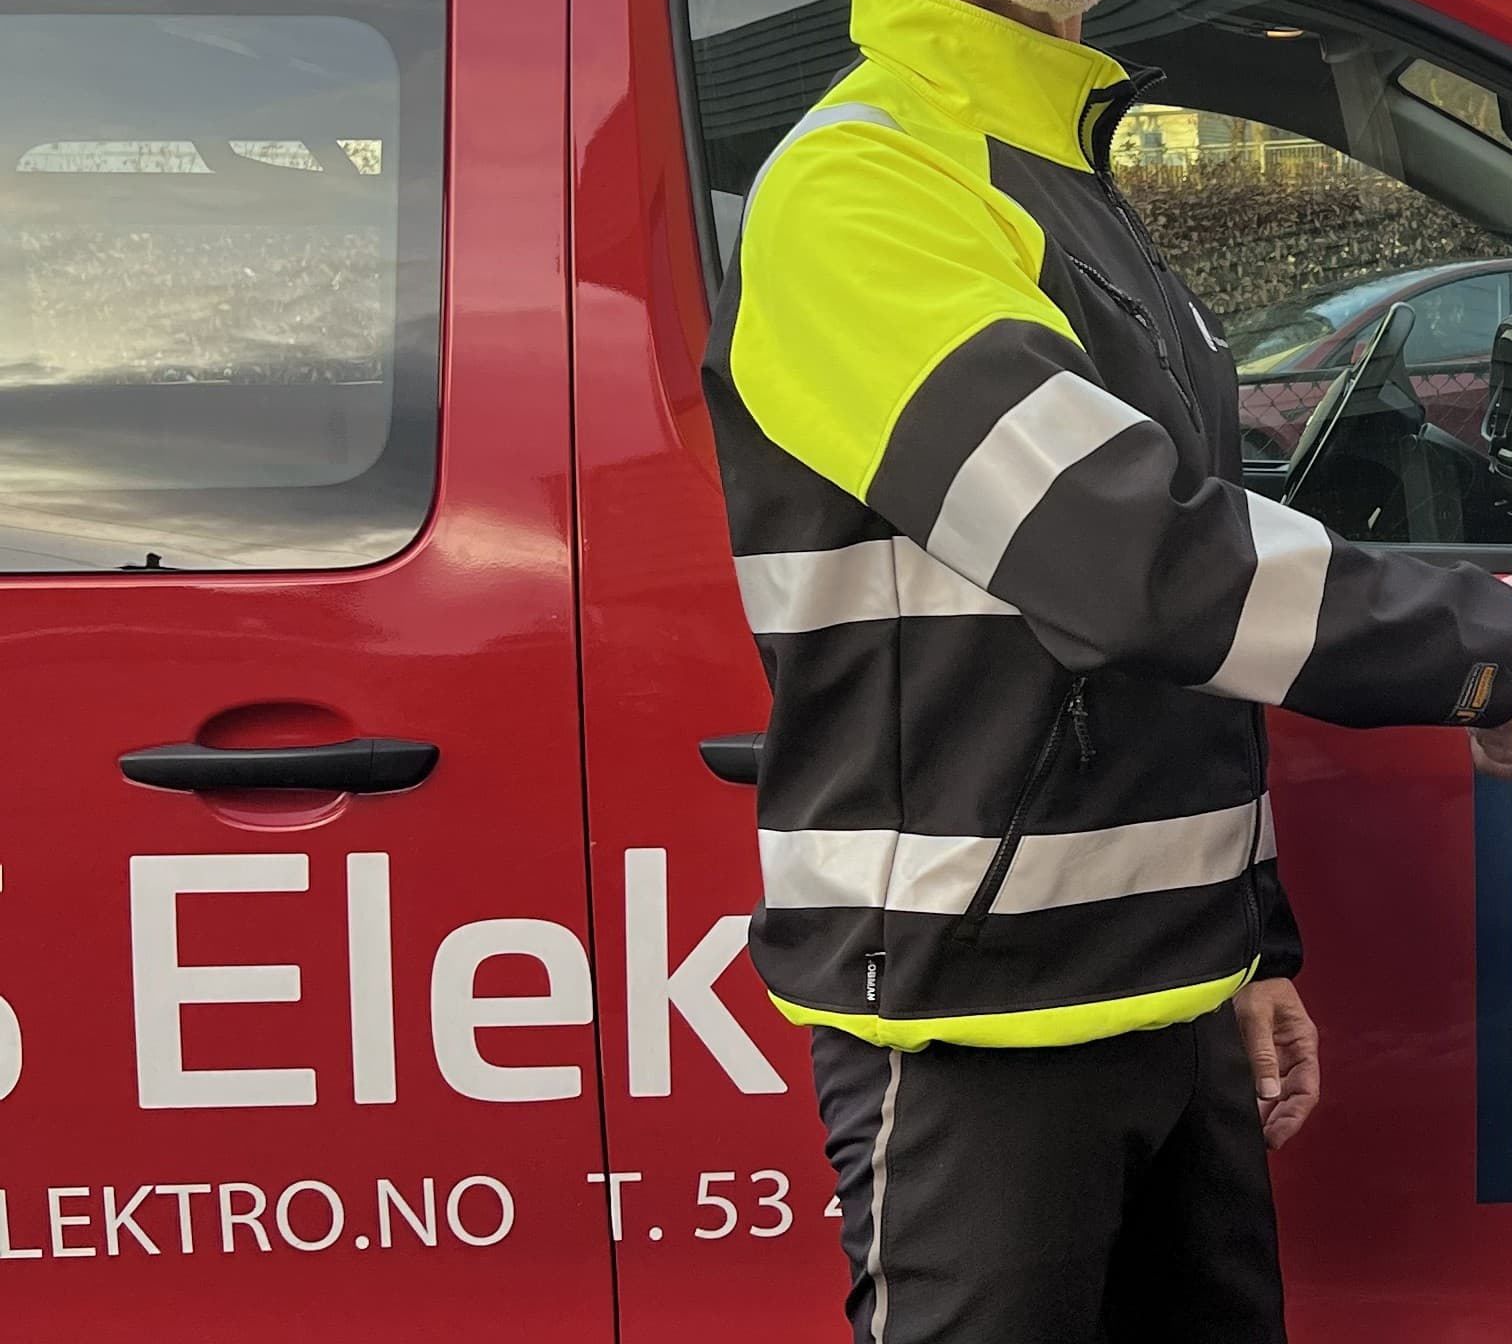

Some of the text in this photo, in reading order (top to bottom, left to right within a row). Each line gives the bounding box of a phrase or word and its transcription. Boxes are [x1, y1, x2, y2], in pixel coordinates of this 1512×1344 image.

[130, 847, 788, 1109] Elek
[586, 1172, 663, 1242] T.
[694, 1169, 794, 1240] 53
